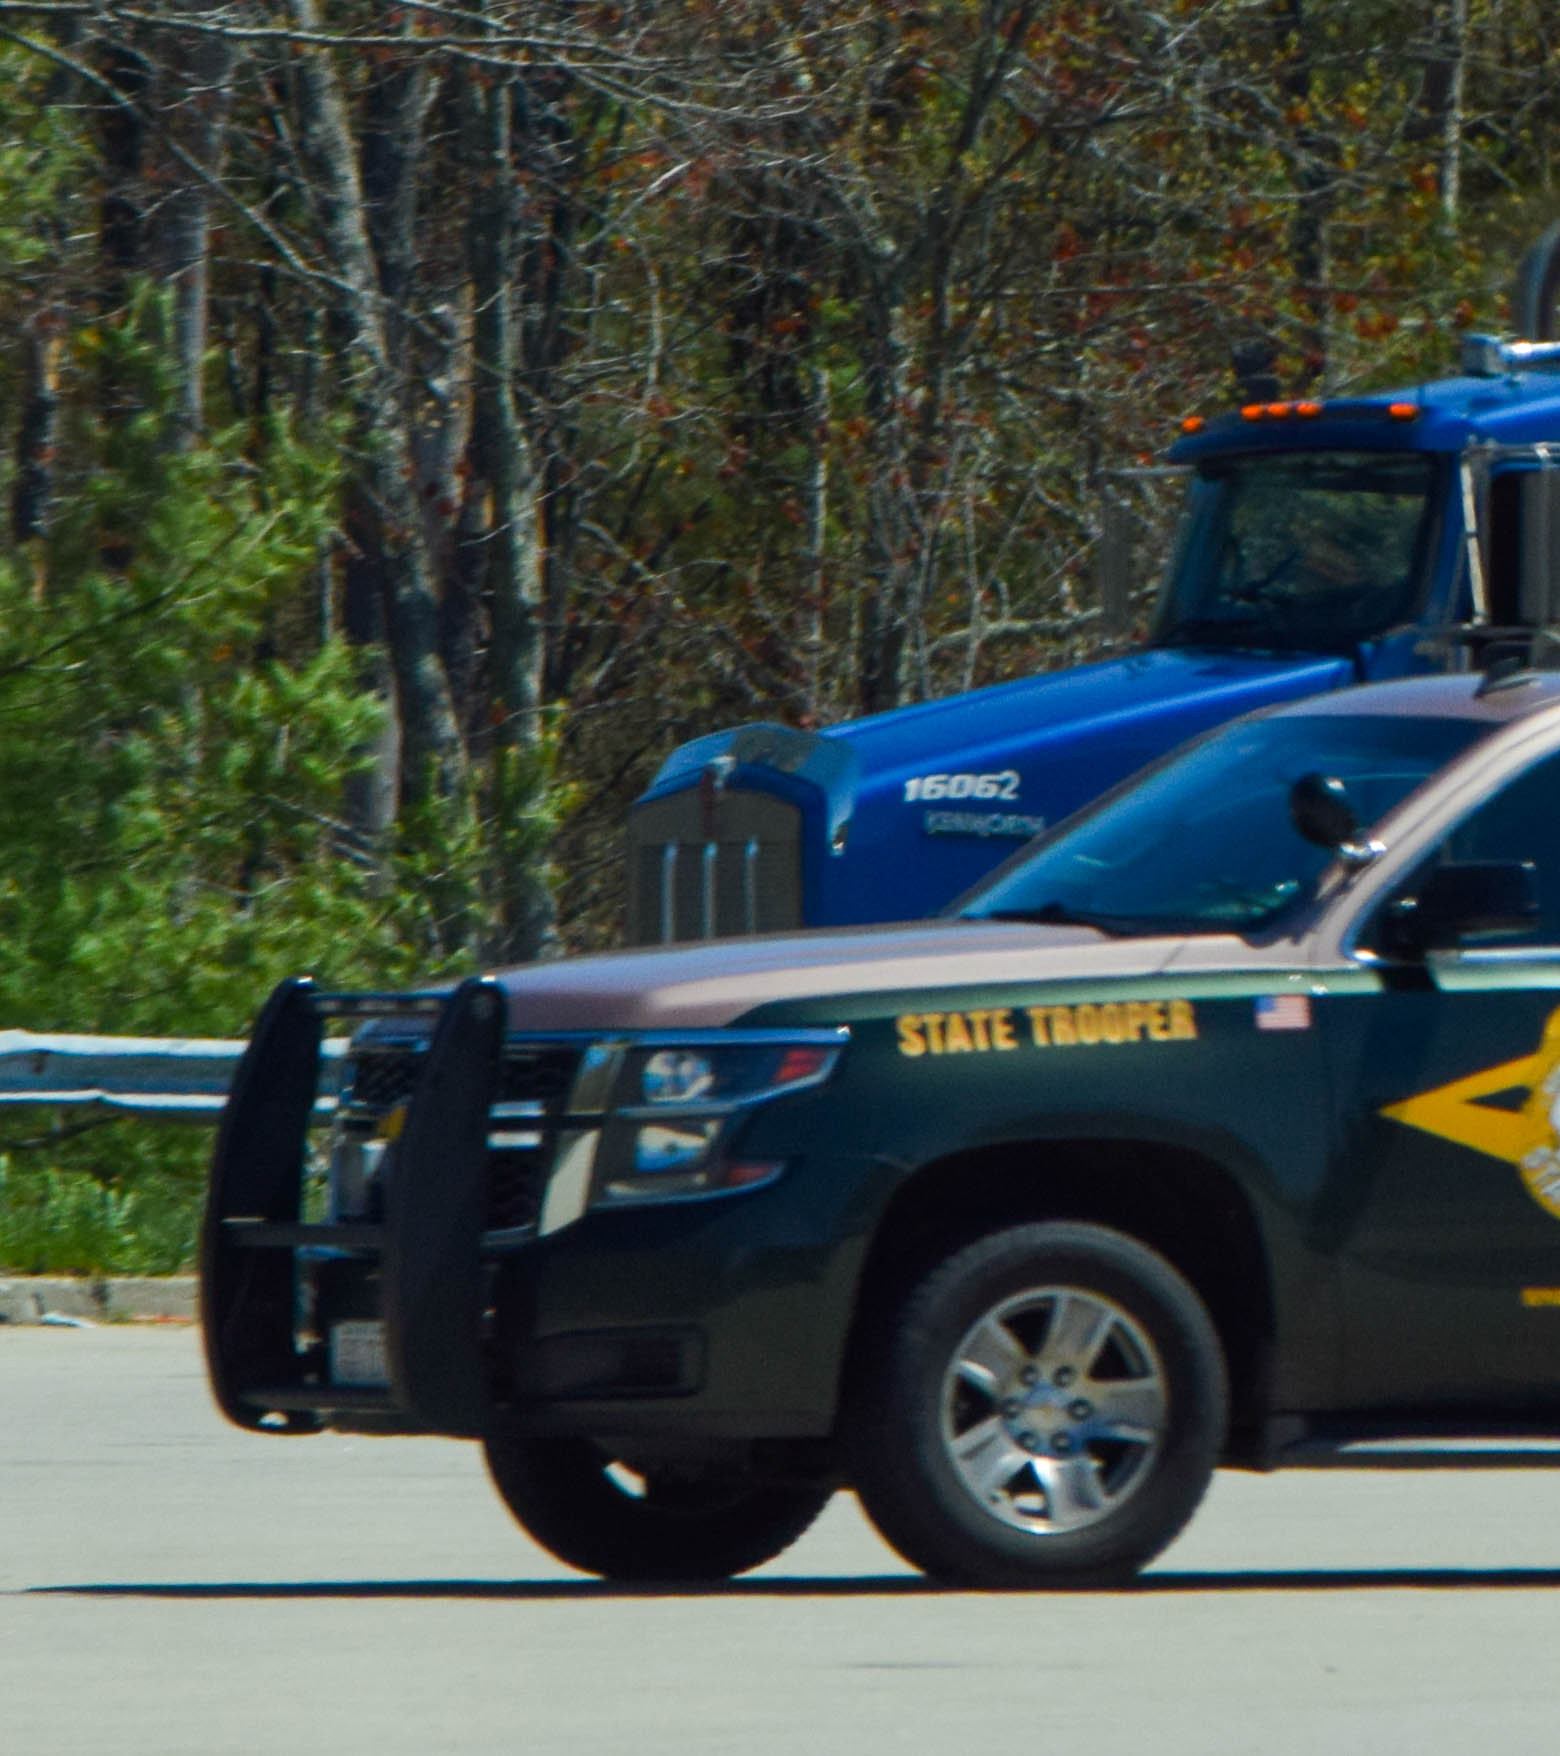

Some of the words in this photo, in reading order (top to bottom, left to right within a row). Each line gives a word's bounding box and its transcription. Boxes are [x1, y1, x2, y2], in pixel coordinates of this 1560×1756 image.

[904, 770, 1020, 801] 16062
[896, 1008, 1019, 1056] STATE
[1027, 999, 1197, 1046] TROOPER
